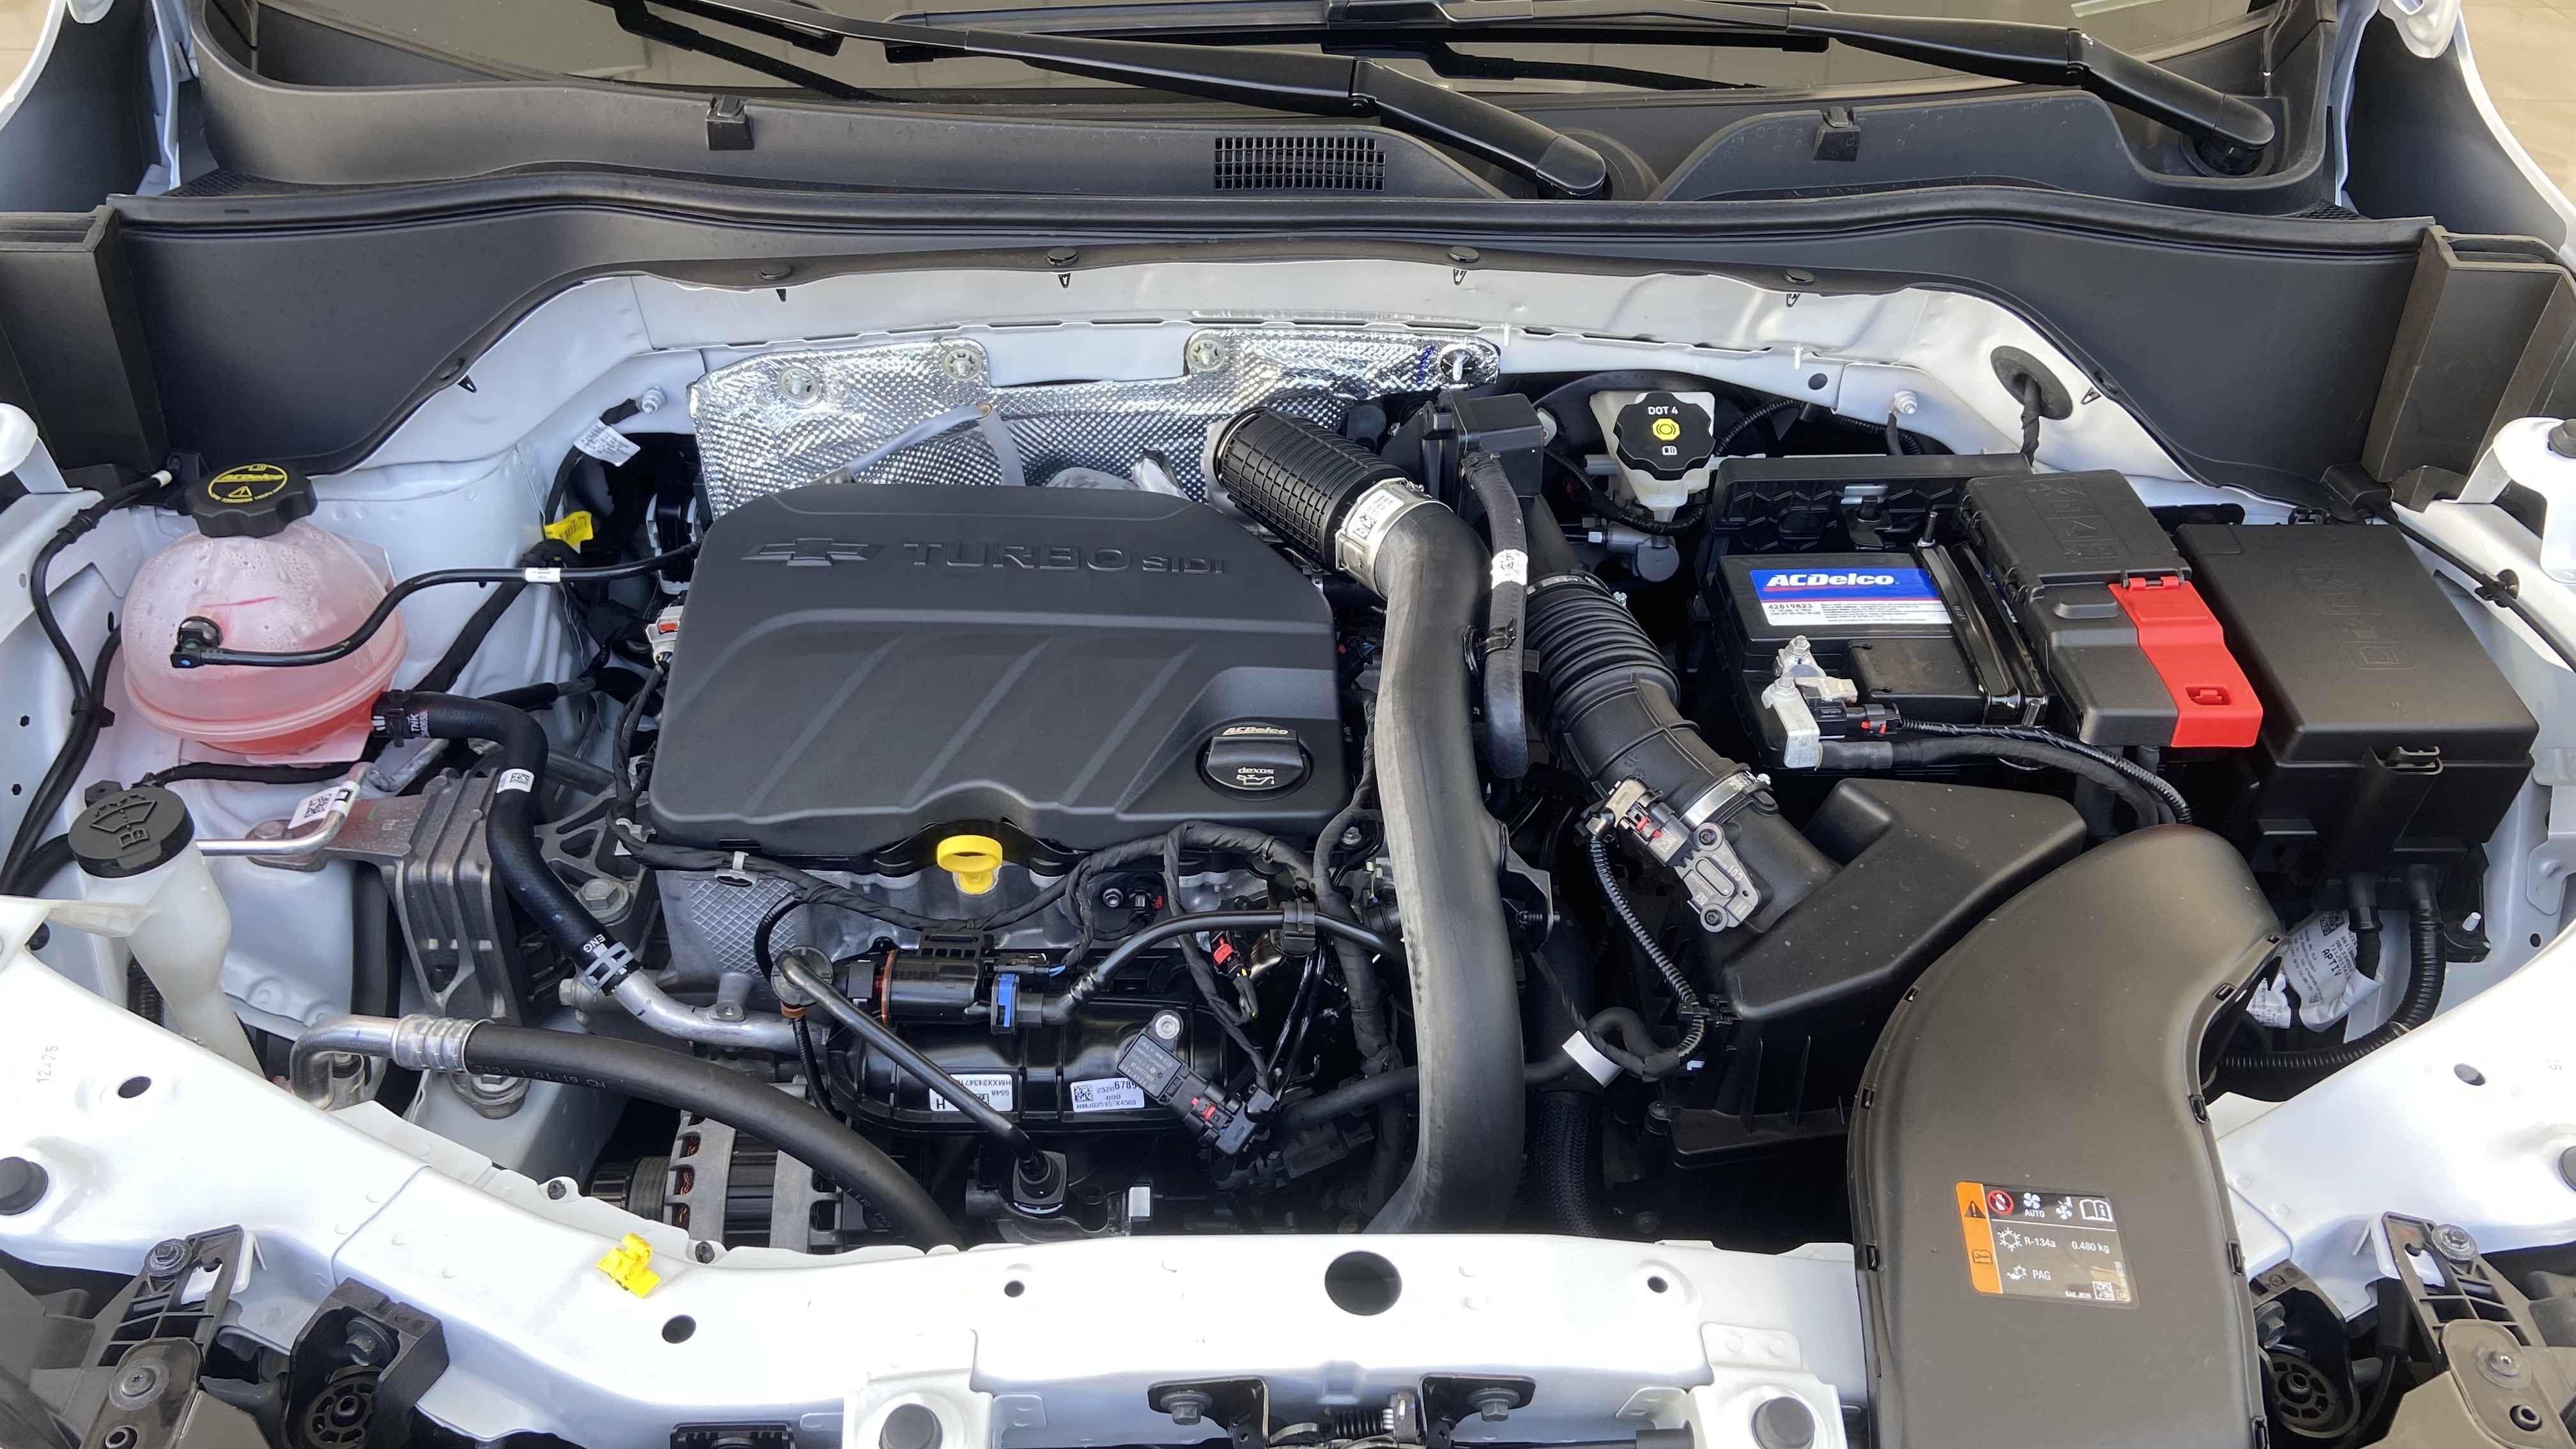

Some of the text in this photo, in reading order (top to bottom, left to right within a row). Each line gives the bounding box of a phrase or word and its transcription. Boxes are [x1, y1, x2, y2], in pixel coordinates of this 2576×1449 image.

[1648, 406, 1678, 415] DOT 4
[903, 542, 1224, 574] TURBO SIDI
[1767, 573, 1894, 586] ACDelco
[1222, 726, 1289, 735] ACDelco
[583, 933, 606, 953] ENG
[2322, 949, 2342, 976] APTIV
[2024, 1209, 2045, 1218] AUTO
[2024, 1236, 2110, 1254] R-134a 0.480 kg
[2032, 1269, 2051, 1280] PAG
